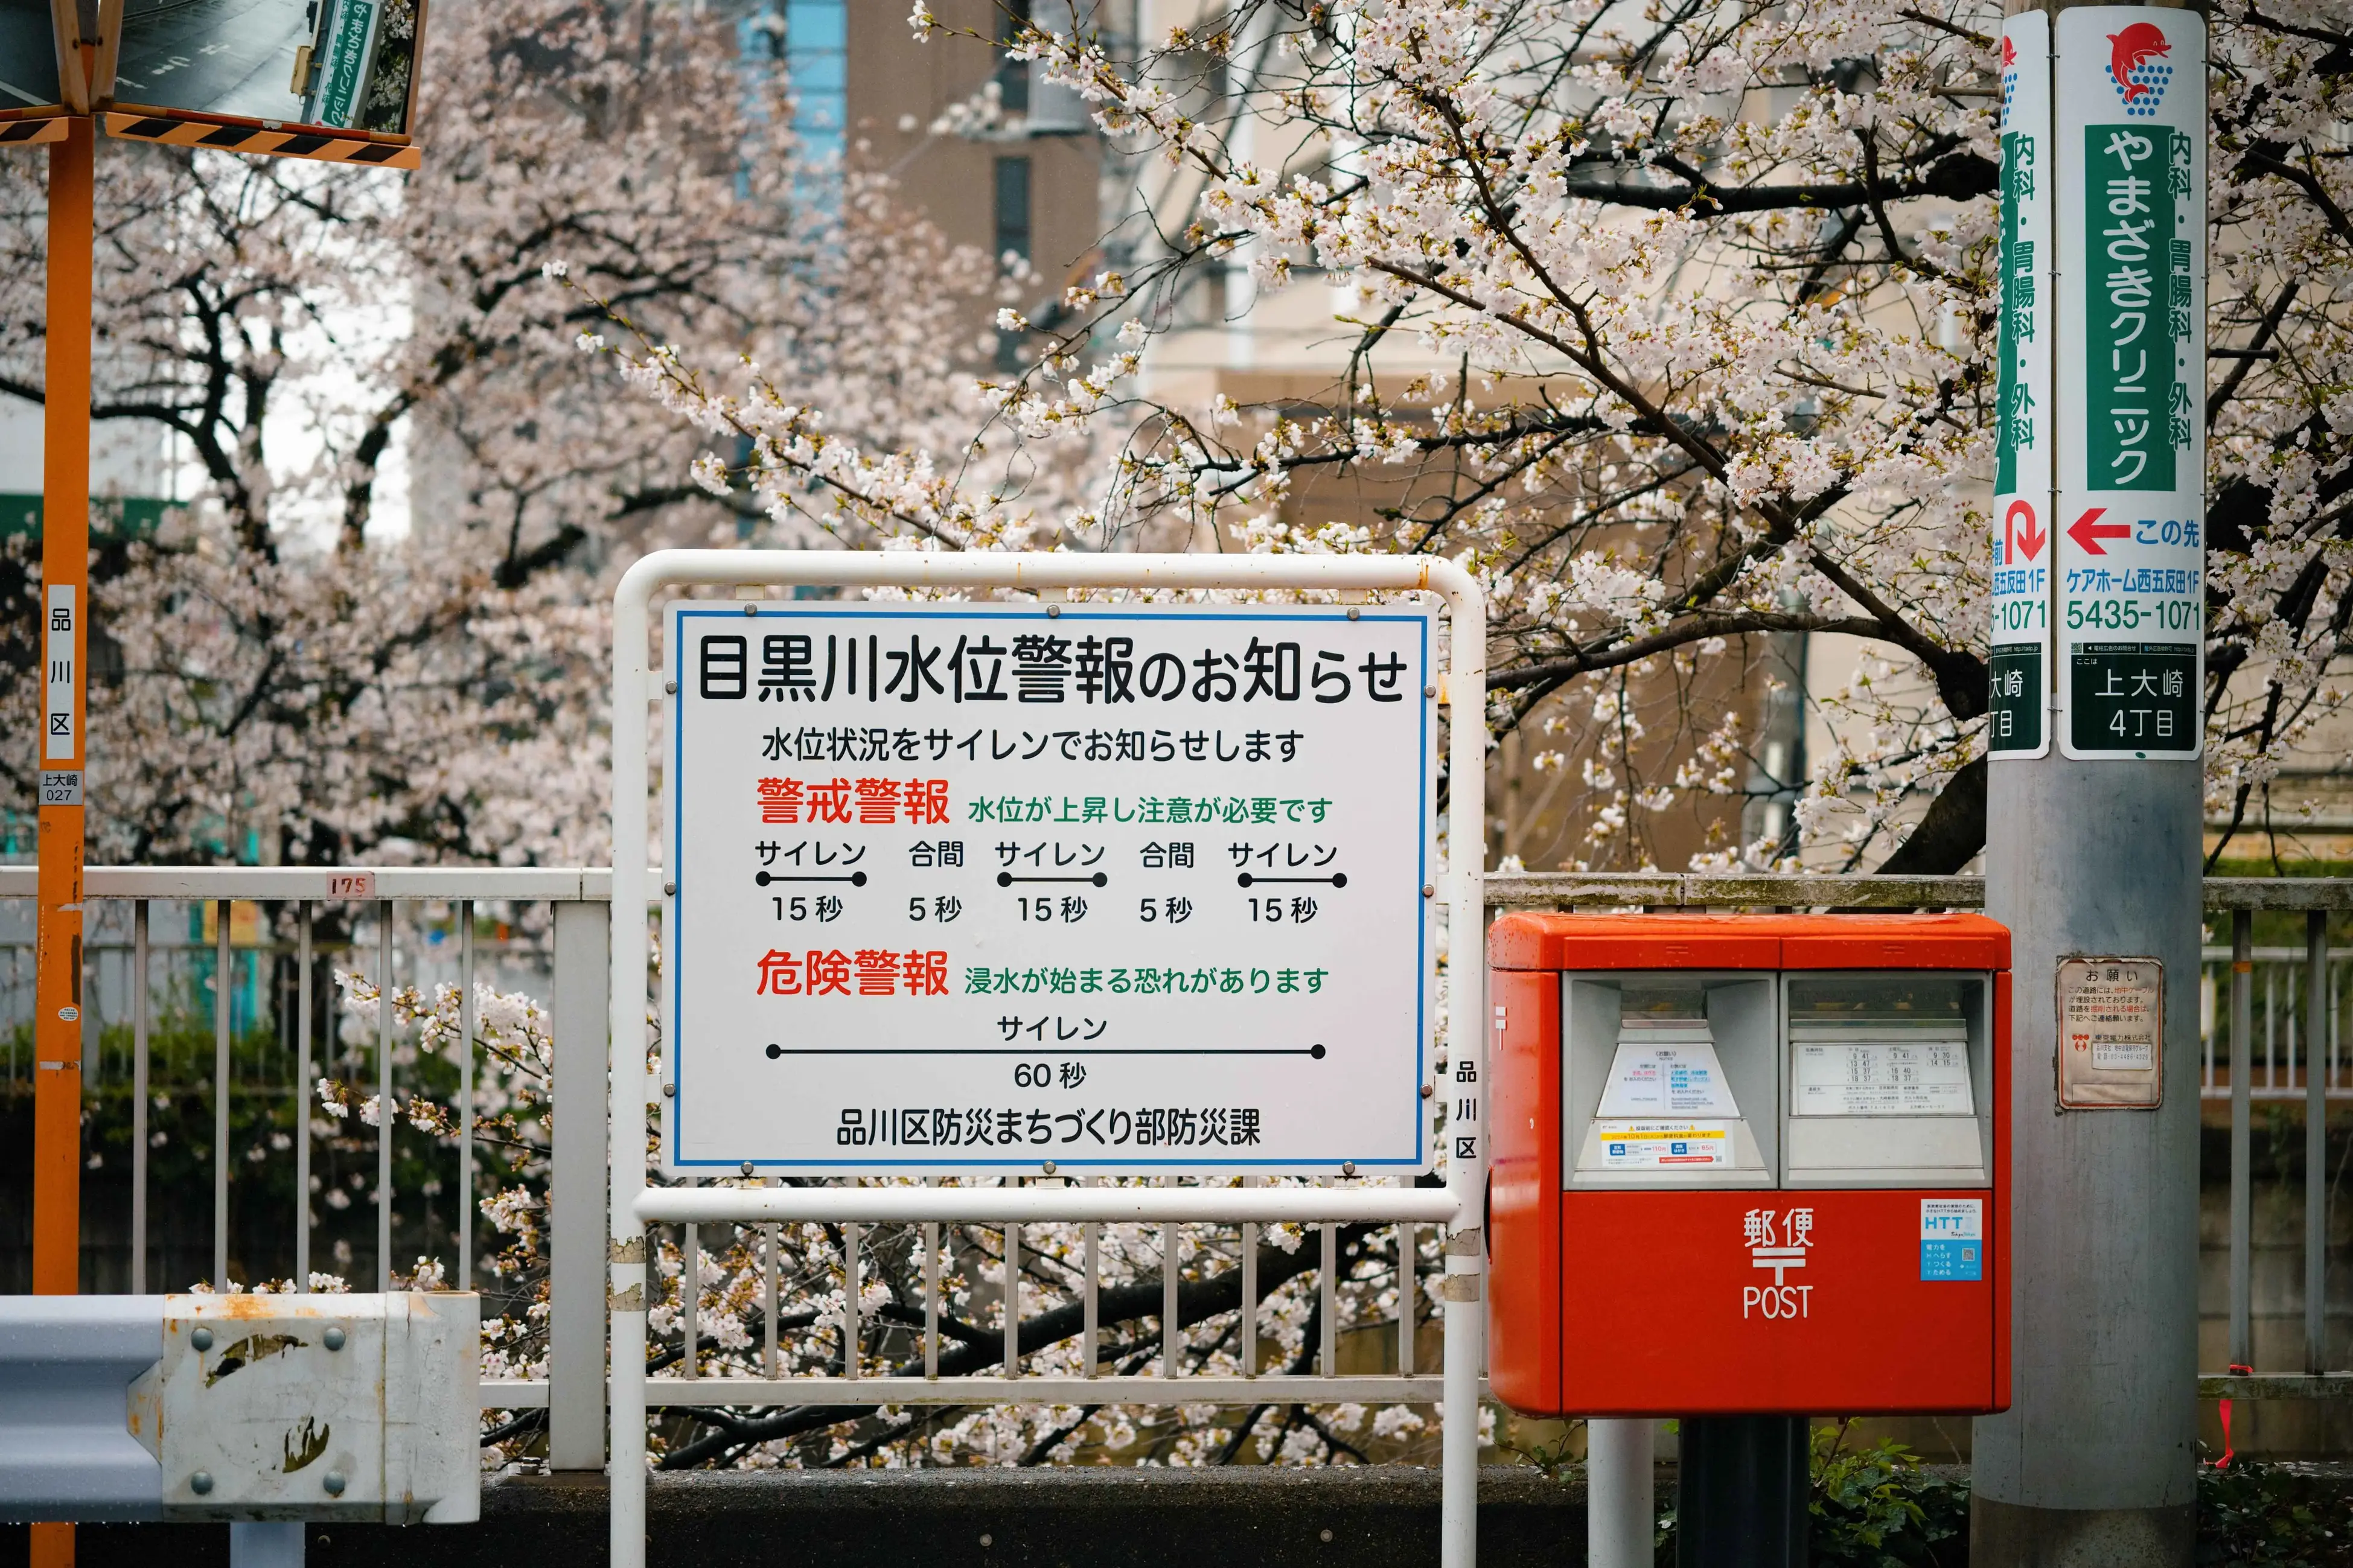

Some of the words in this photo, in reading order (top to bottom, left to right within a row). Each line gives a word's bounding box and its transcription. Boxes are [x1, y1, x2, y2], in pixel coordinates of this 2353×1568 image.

[2012, 133, 2035, 451] 内科・胃腸科・外科
[2168, 131, 2192, 451] 内科・胃腸科・外科
[2104, 131, 2156, 485] やまざきクリニック
[2136, 520, 2200, 547] この先
[1991, 569, 2045, 596] 西五反田1F
[2067, 569, 2200, 594] ケアホーム西五反田1F
[2067, 601, 2200, 630] 5435-1071
[51, 608, 71, 735] 品川区
[700, 634, 1407, 704] 目黒川水位警報のお知らせ
[2095, 669, 2184, 698] 上大崎
[2109, 709, 2173, 738] 4丁目
[762, 727, 1303, 762] 水位状況をサイレンでお知らせします
[43, 774, 77, 786] 上大崎
[46, 790, 72, 801] 027
[757, 777, 950, 824] 警戒警報
[968, 795, 1332, 824] 水位が上昇し注意が必要です
[755, 841, 866, 866] サイレン
[908, 841, 963, 867] 合間
[995, 841, 1105, 867] サイレン
[1140, 841, 1194, 868] 合間
[1228, 842, 1337, 867] サイレン
[333, 878, 366, 895] 175
[756, 949, 949, 996] 危険警報
[965, 967, 1329, 994] 浸水が始まる恐れがあります
[2086, 969, 2137, 981] お願い
[997, 1016, 1107, 1041] サイレン
[1456, 1061, 1477, 1158] 品川区
[837, 1107, 1260, 1146] 品川区防災まちづくり部防災課
[1744, 1208, 1813, 1247] 郵便
[1925, 1217, 1963, 1229] HTT
[1743, 1286, 1813, 1319] POST
